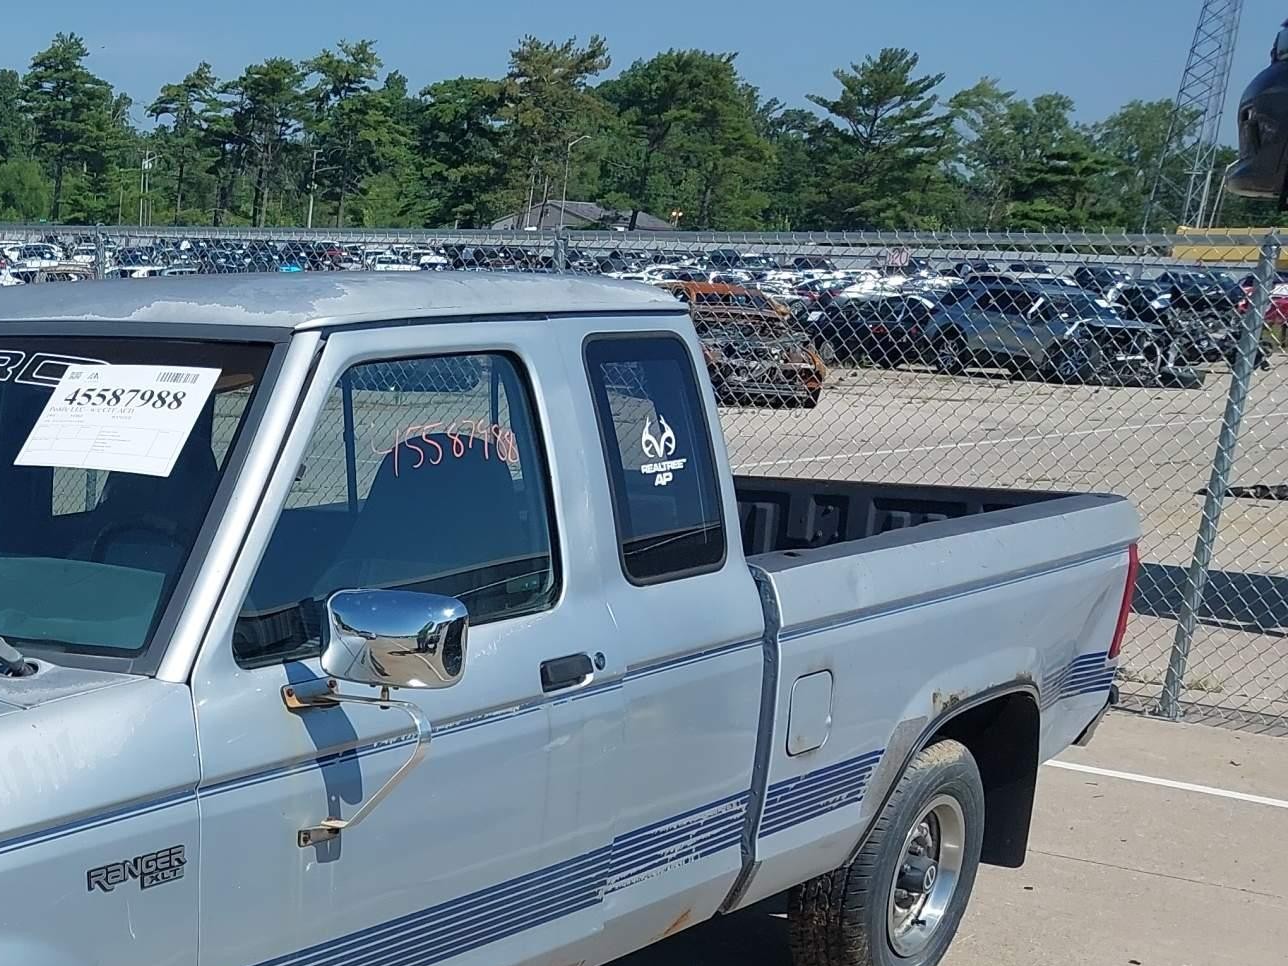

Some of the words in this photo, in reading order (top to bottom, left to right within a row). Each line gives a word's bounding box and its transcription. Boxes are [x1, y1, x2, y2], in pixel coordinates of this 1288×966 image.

[64, 387, 187, 410] 45587988
[371, 419, 520, 478] 45587988
[654, 472, 673, 487] AP
[148, 867, 182, 884] XLT
